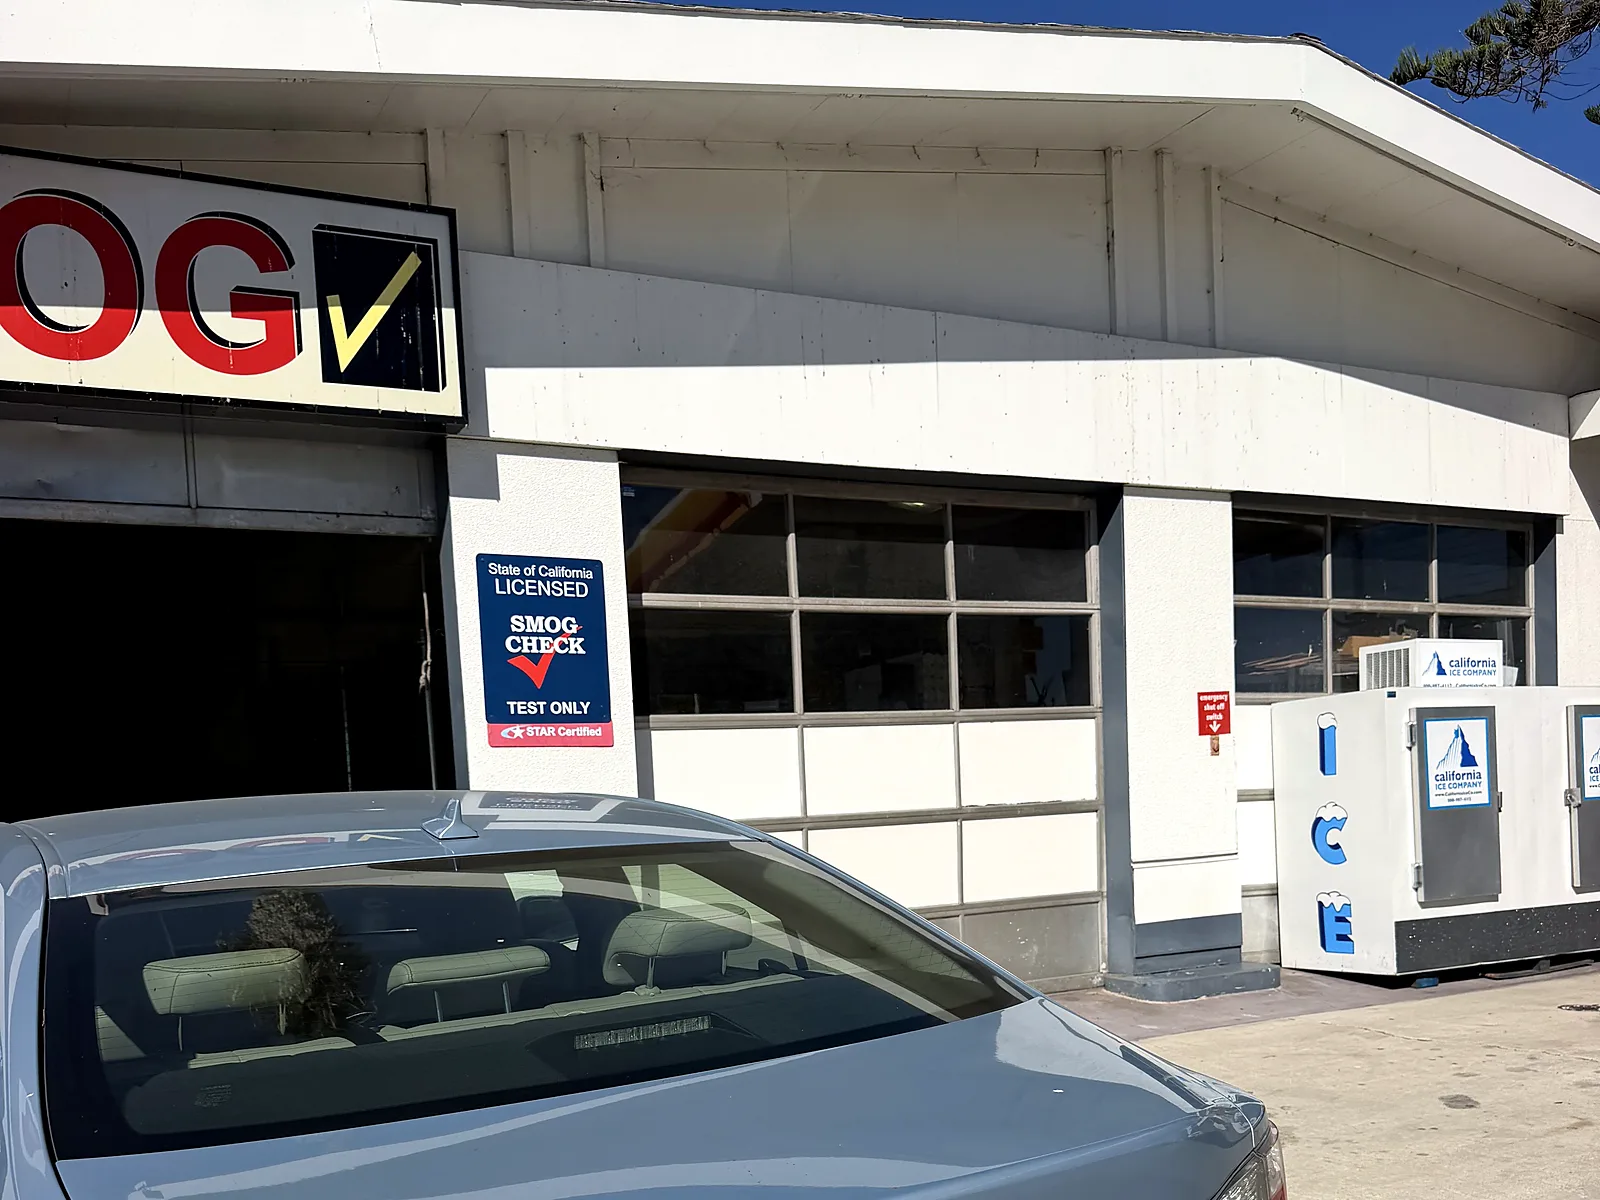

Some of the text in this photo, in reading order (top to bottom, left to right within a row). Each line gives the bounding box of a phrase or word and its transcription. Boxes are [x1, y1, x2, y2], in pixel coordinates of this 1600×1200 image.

[488, 562, 594, 580] State of California
[495, 578, 589, 598] LICENSED
[510, 614, 579, 634] SMOG
[505, 635, 586, 655] CHECK
[1449, 657, 1497, 668] california
[1449, 669, 1497, 677] ICE COMPANY
[1200, 694, 1228, 702] emergency
[506, 701, 591, 715] TEST ONLY
[1203, 702, 1225, 711] shut off
[1206, 712, 1223, 721] switch
[526, 726, 602, 737] STAR Certified
[1434, 769, 1482, 782] california
[1435, 781, 1482, 790] ICE COMPANY
[1311, 711, 1355, 955] ICE
